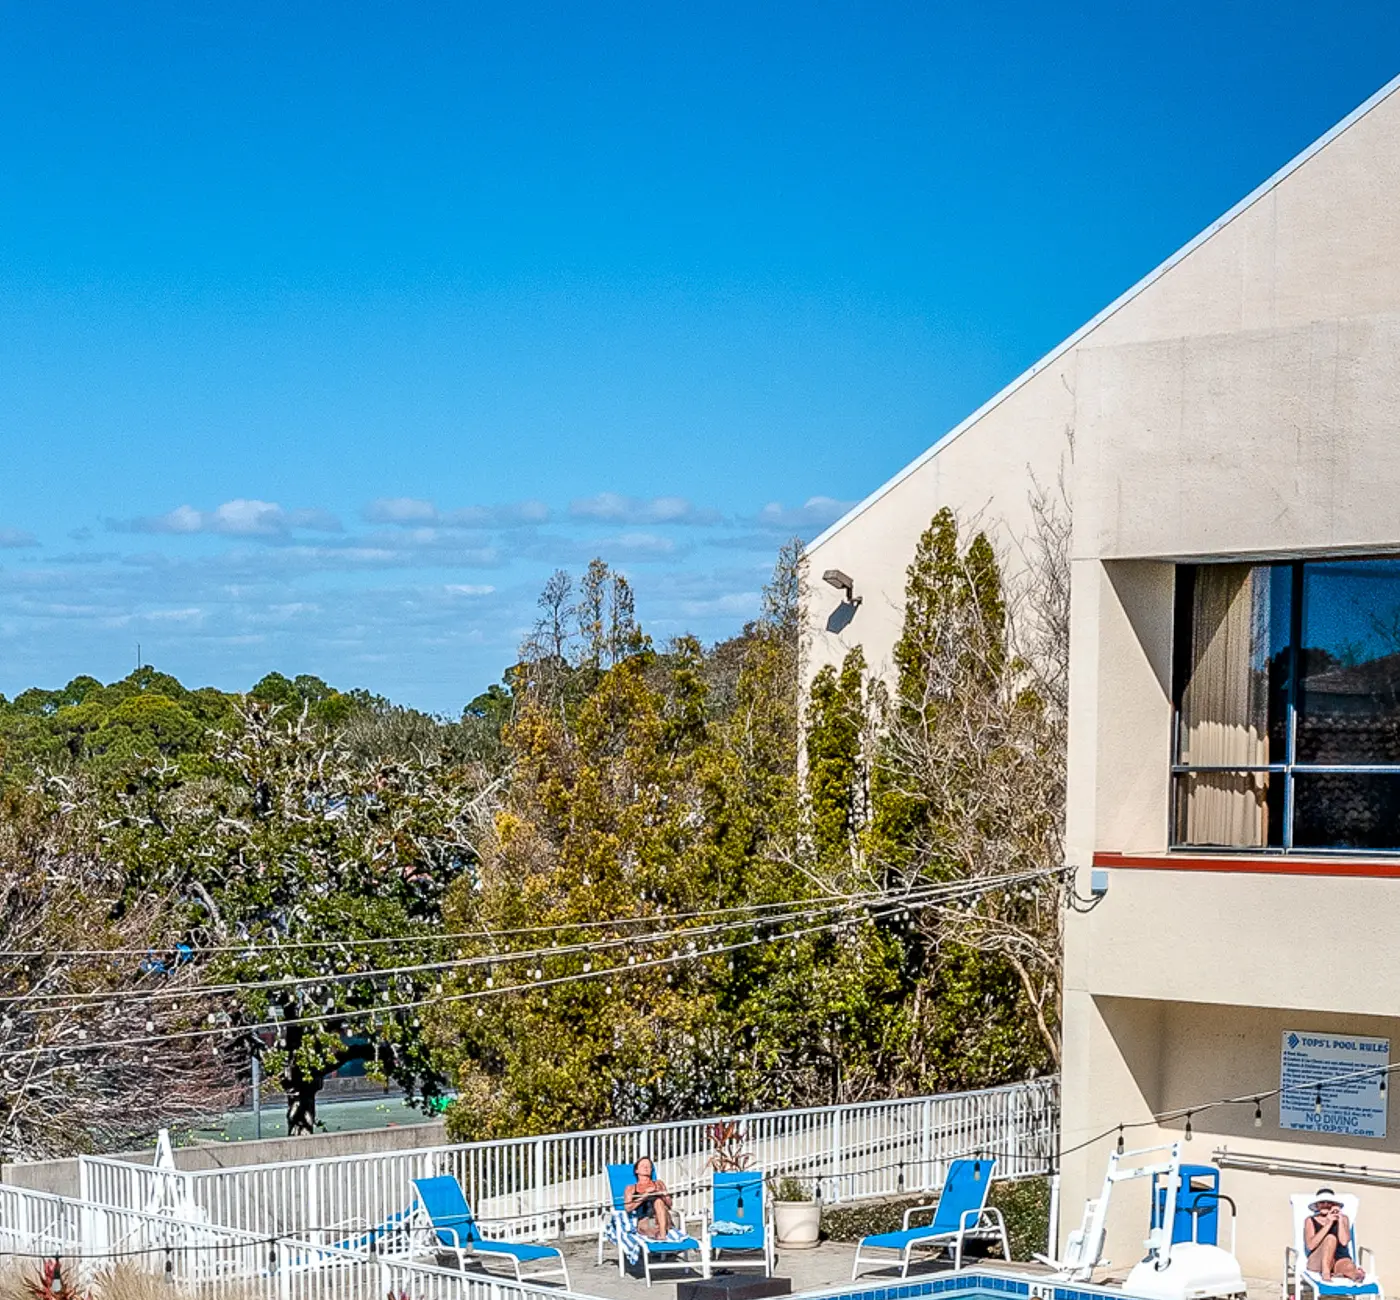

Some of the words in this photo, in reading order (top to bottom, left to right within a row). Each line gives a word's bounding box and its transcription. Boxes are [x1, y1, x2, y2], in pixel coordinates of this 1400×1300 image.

[1333, 1040, 1357, 1051] POOL
[1359, 1042, 1388, 1053] RULES
[1306, 1112, 1321, 1123] NO
[1323, 1115, 1358, 1127] DIVING
[1032, 1286, 1039, 1296] 4
